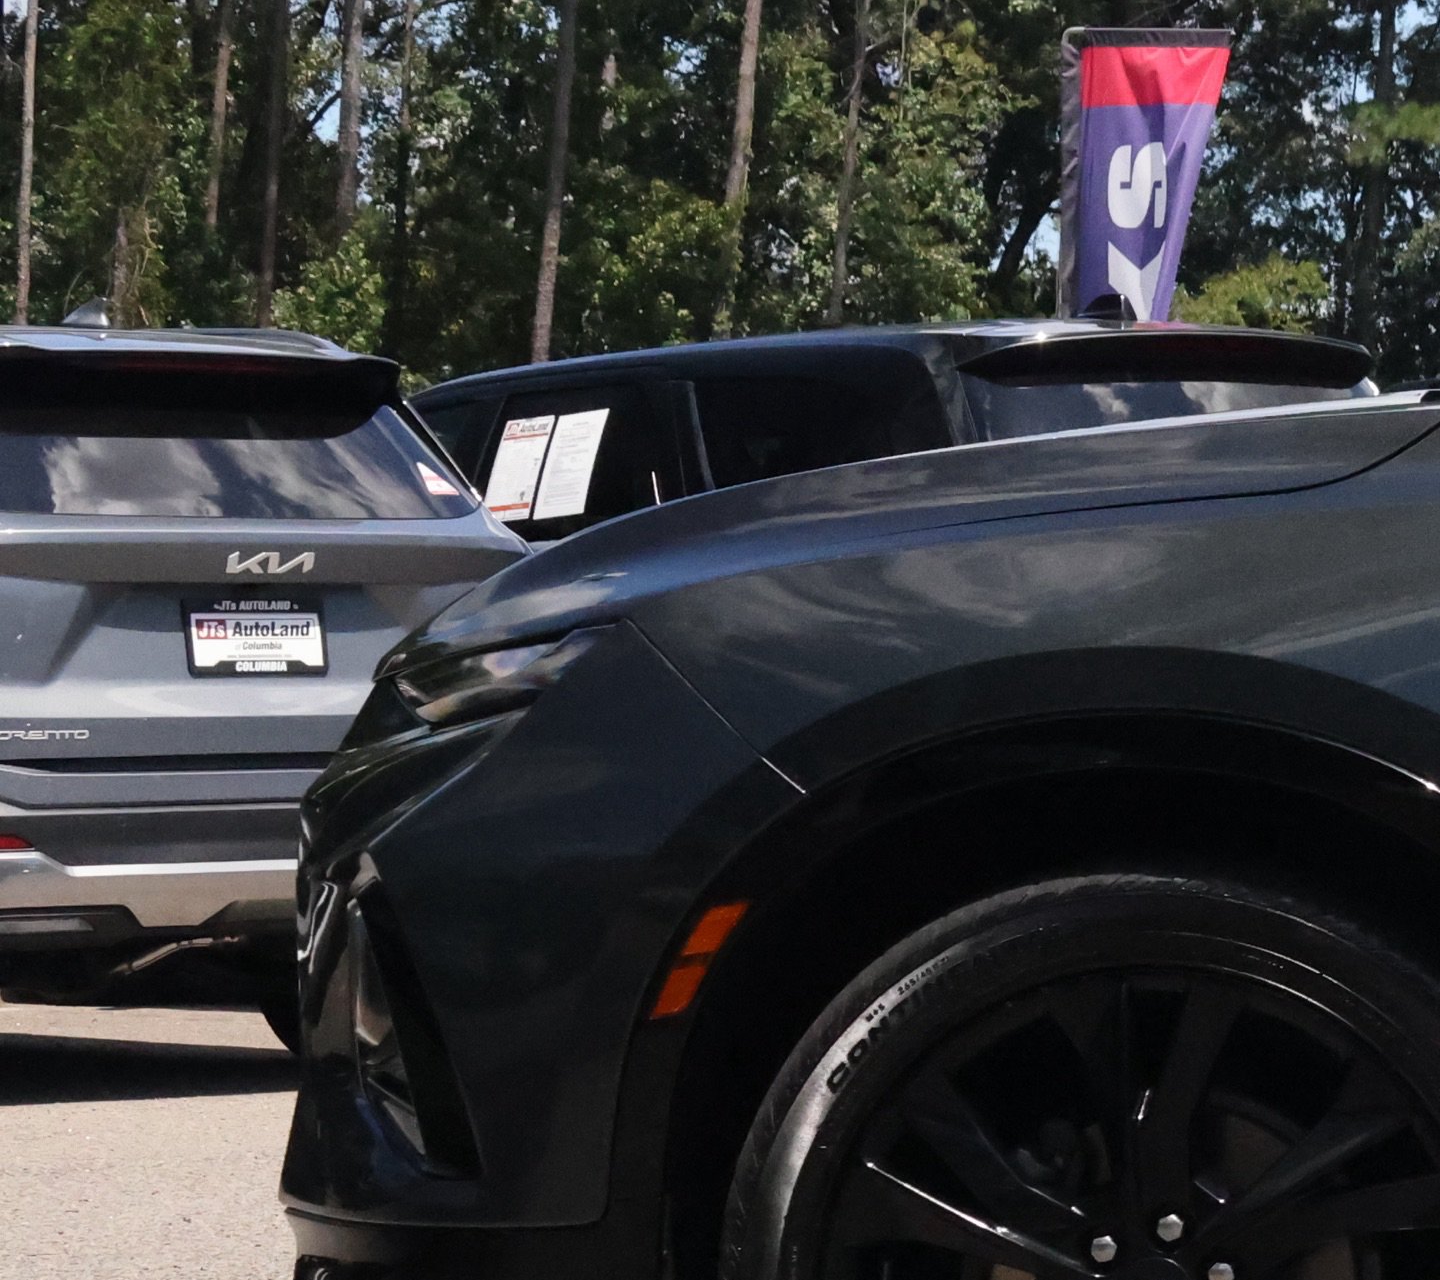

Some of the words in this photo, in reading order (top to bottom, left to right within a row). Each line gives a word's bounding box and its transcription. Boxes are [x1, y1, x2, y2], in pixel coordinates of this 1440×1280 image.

[225, 551, 316, 574] KIA
[238, 600, 291, 611] AUTOLAND
[198, 621, 226, 638] JTs
[231, 621, 311, 637] AutoLand
[242, 641, 283, 650] Columbia
[235, 661, 288, 672] COLUMBIA
